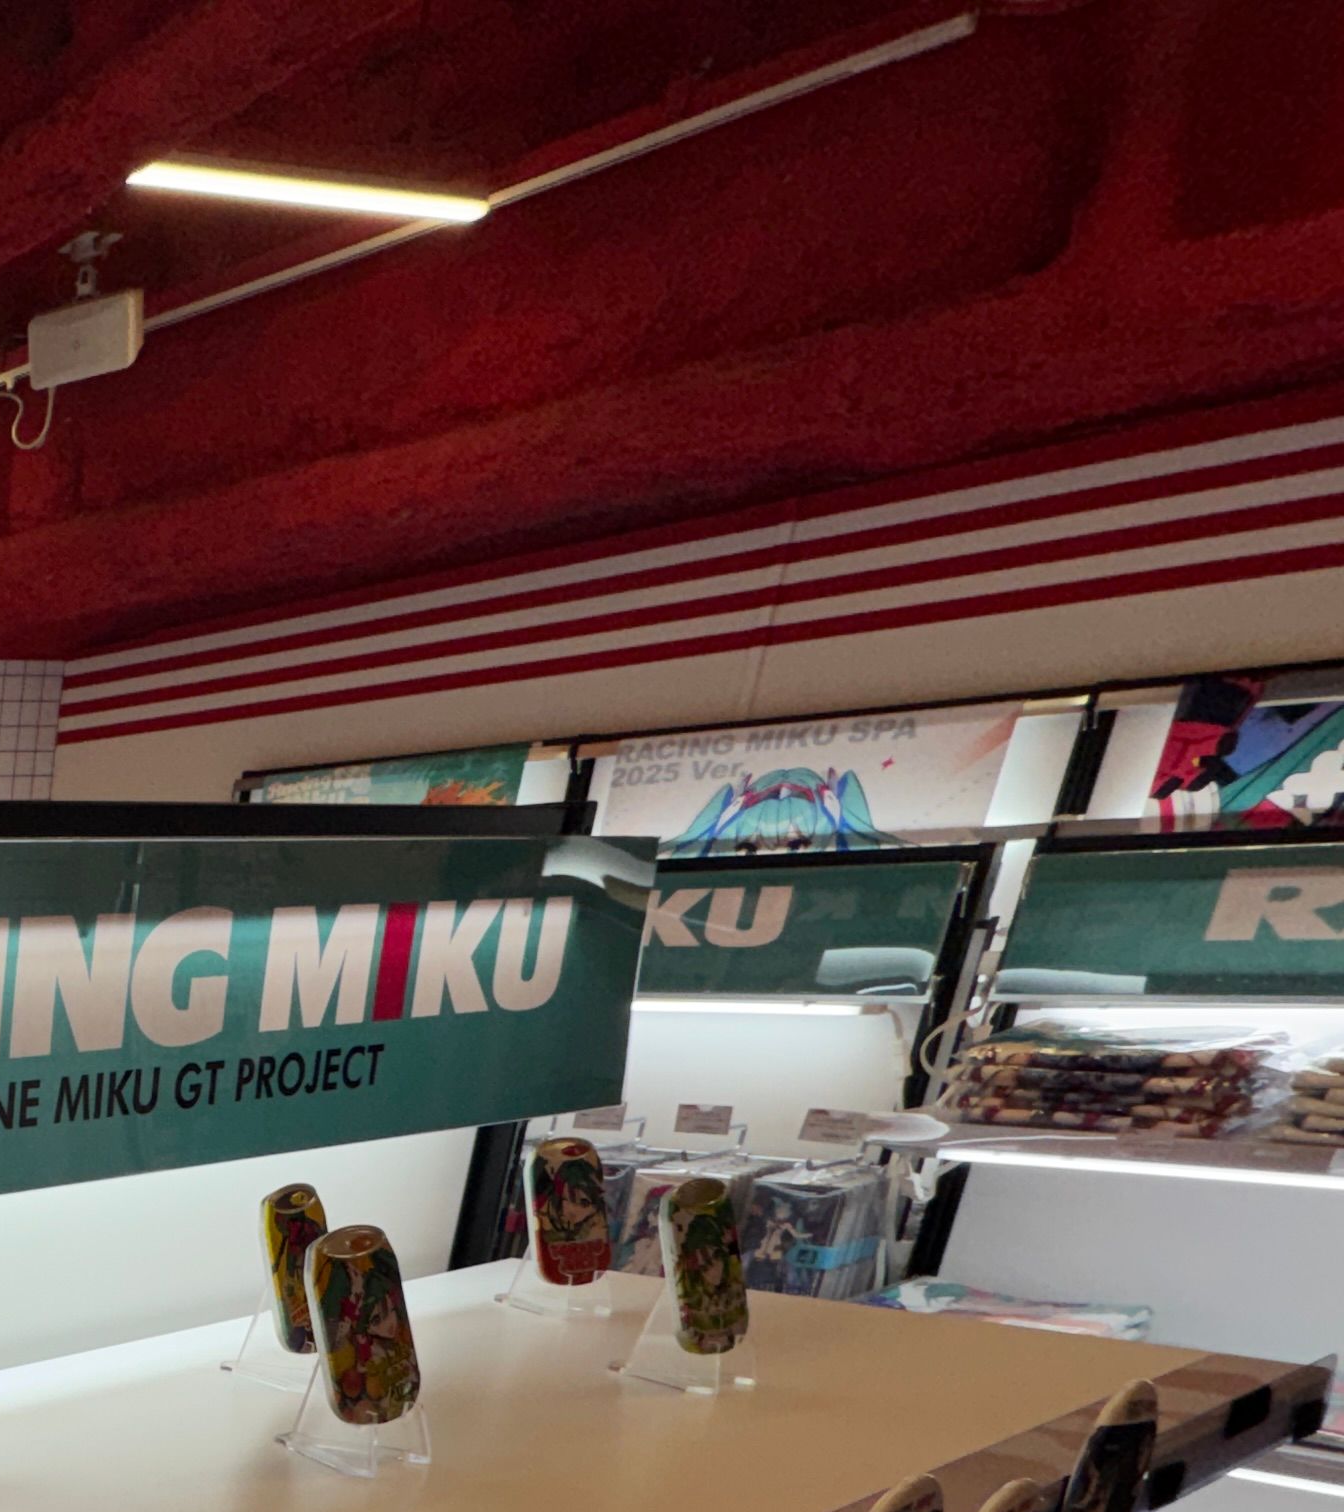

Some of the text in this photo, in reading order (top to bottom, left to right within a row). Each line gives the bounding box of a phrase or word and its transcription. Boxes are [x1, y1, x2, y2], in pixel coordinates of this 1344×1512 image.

[611, 760, 680, 788] 2025
[615, 716, 919, 764] RACING MIKU SPA
[1204, 864, 1344, 941] R
[258, 896, 574, 1033] MIKU
[54, 1065, 161, 1124] MIKU
[174, 1058, 226, 1109] GT
[234, 1043, 386, 1103] PROJECT
